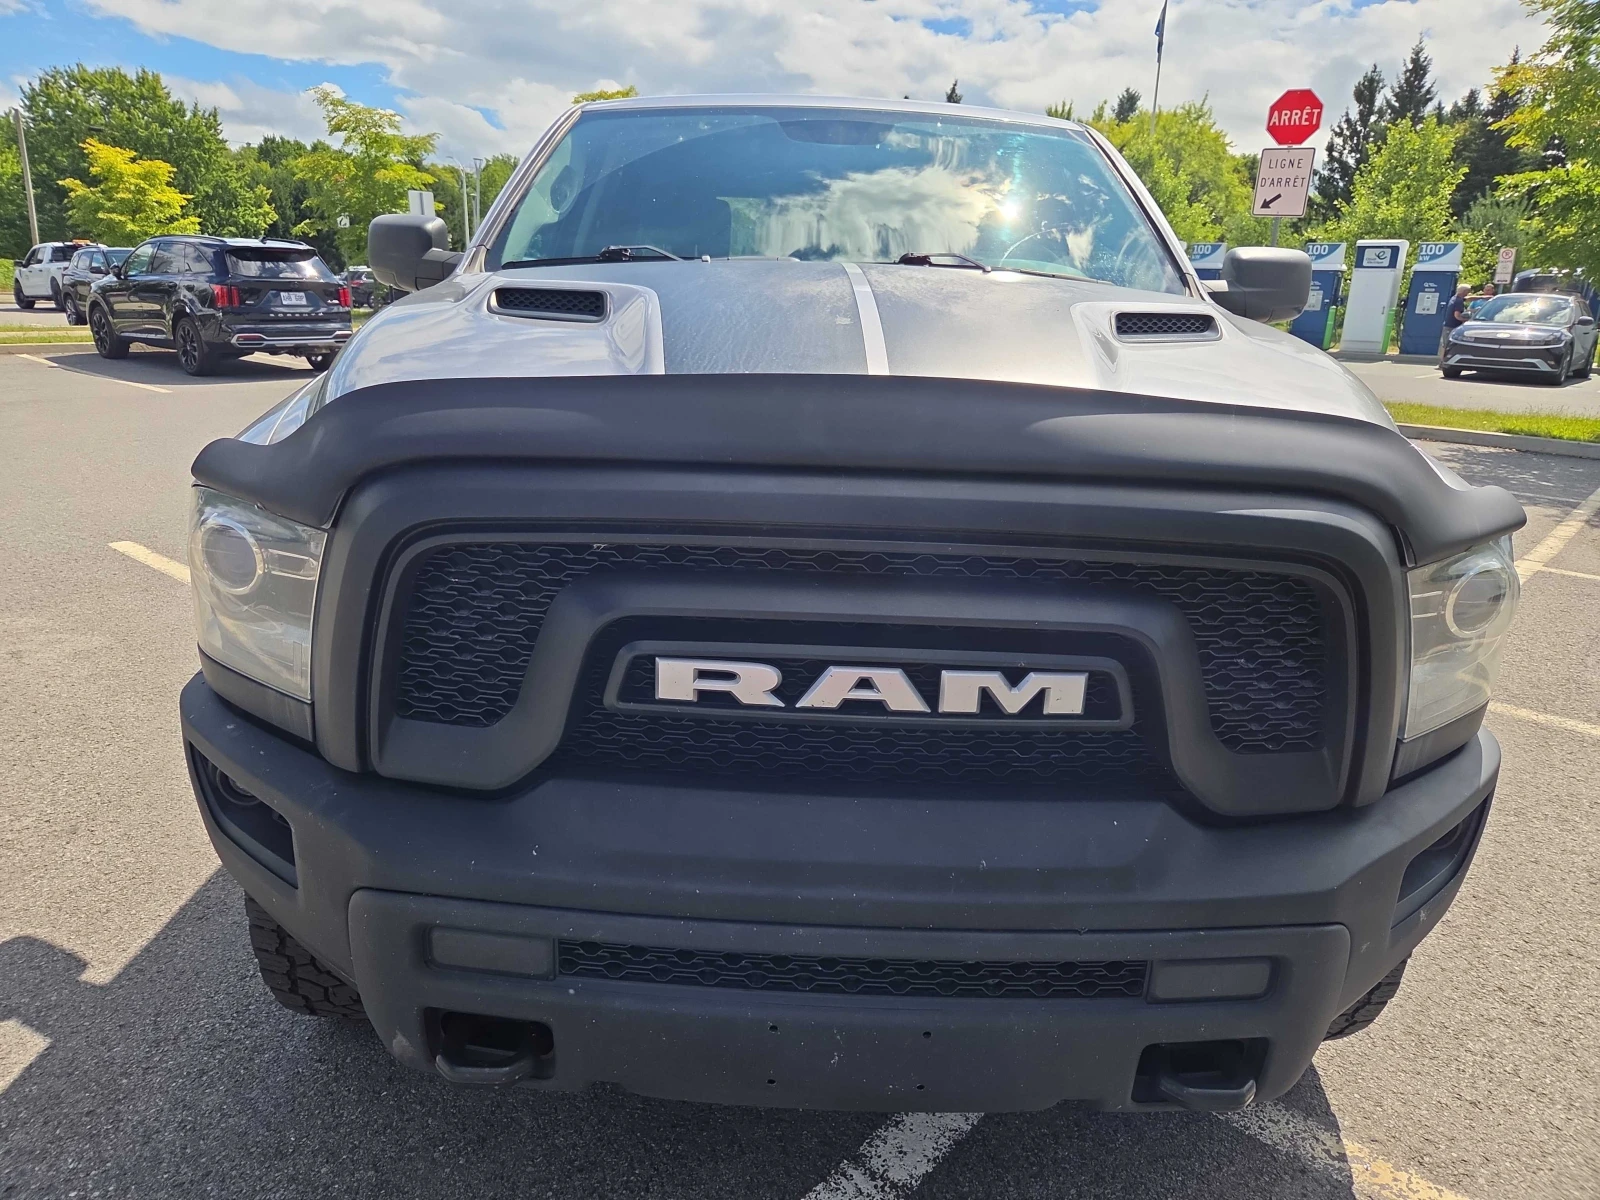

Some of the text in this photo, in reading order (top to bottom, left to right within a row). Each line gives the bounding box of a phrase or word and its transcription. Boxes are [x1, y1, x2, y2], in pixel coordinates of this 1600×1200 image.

[1269, 106, 1321, 126] ARRÊT
[1268, 158, 1304, 169] LIGNE
[1260, 175, 1306, 188] D'ARRÊT
[1193, 244, 1211, 255] 100
[1307, 244, 1329, 255] 100
[1420, 244, 1445, 255] 100
[655, 657, 1089, 714] RAM
